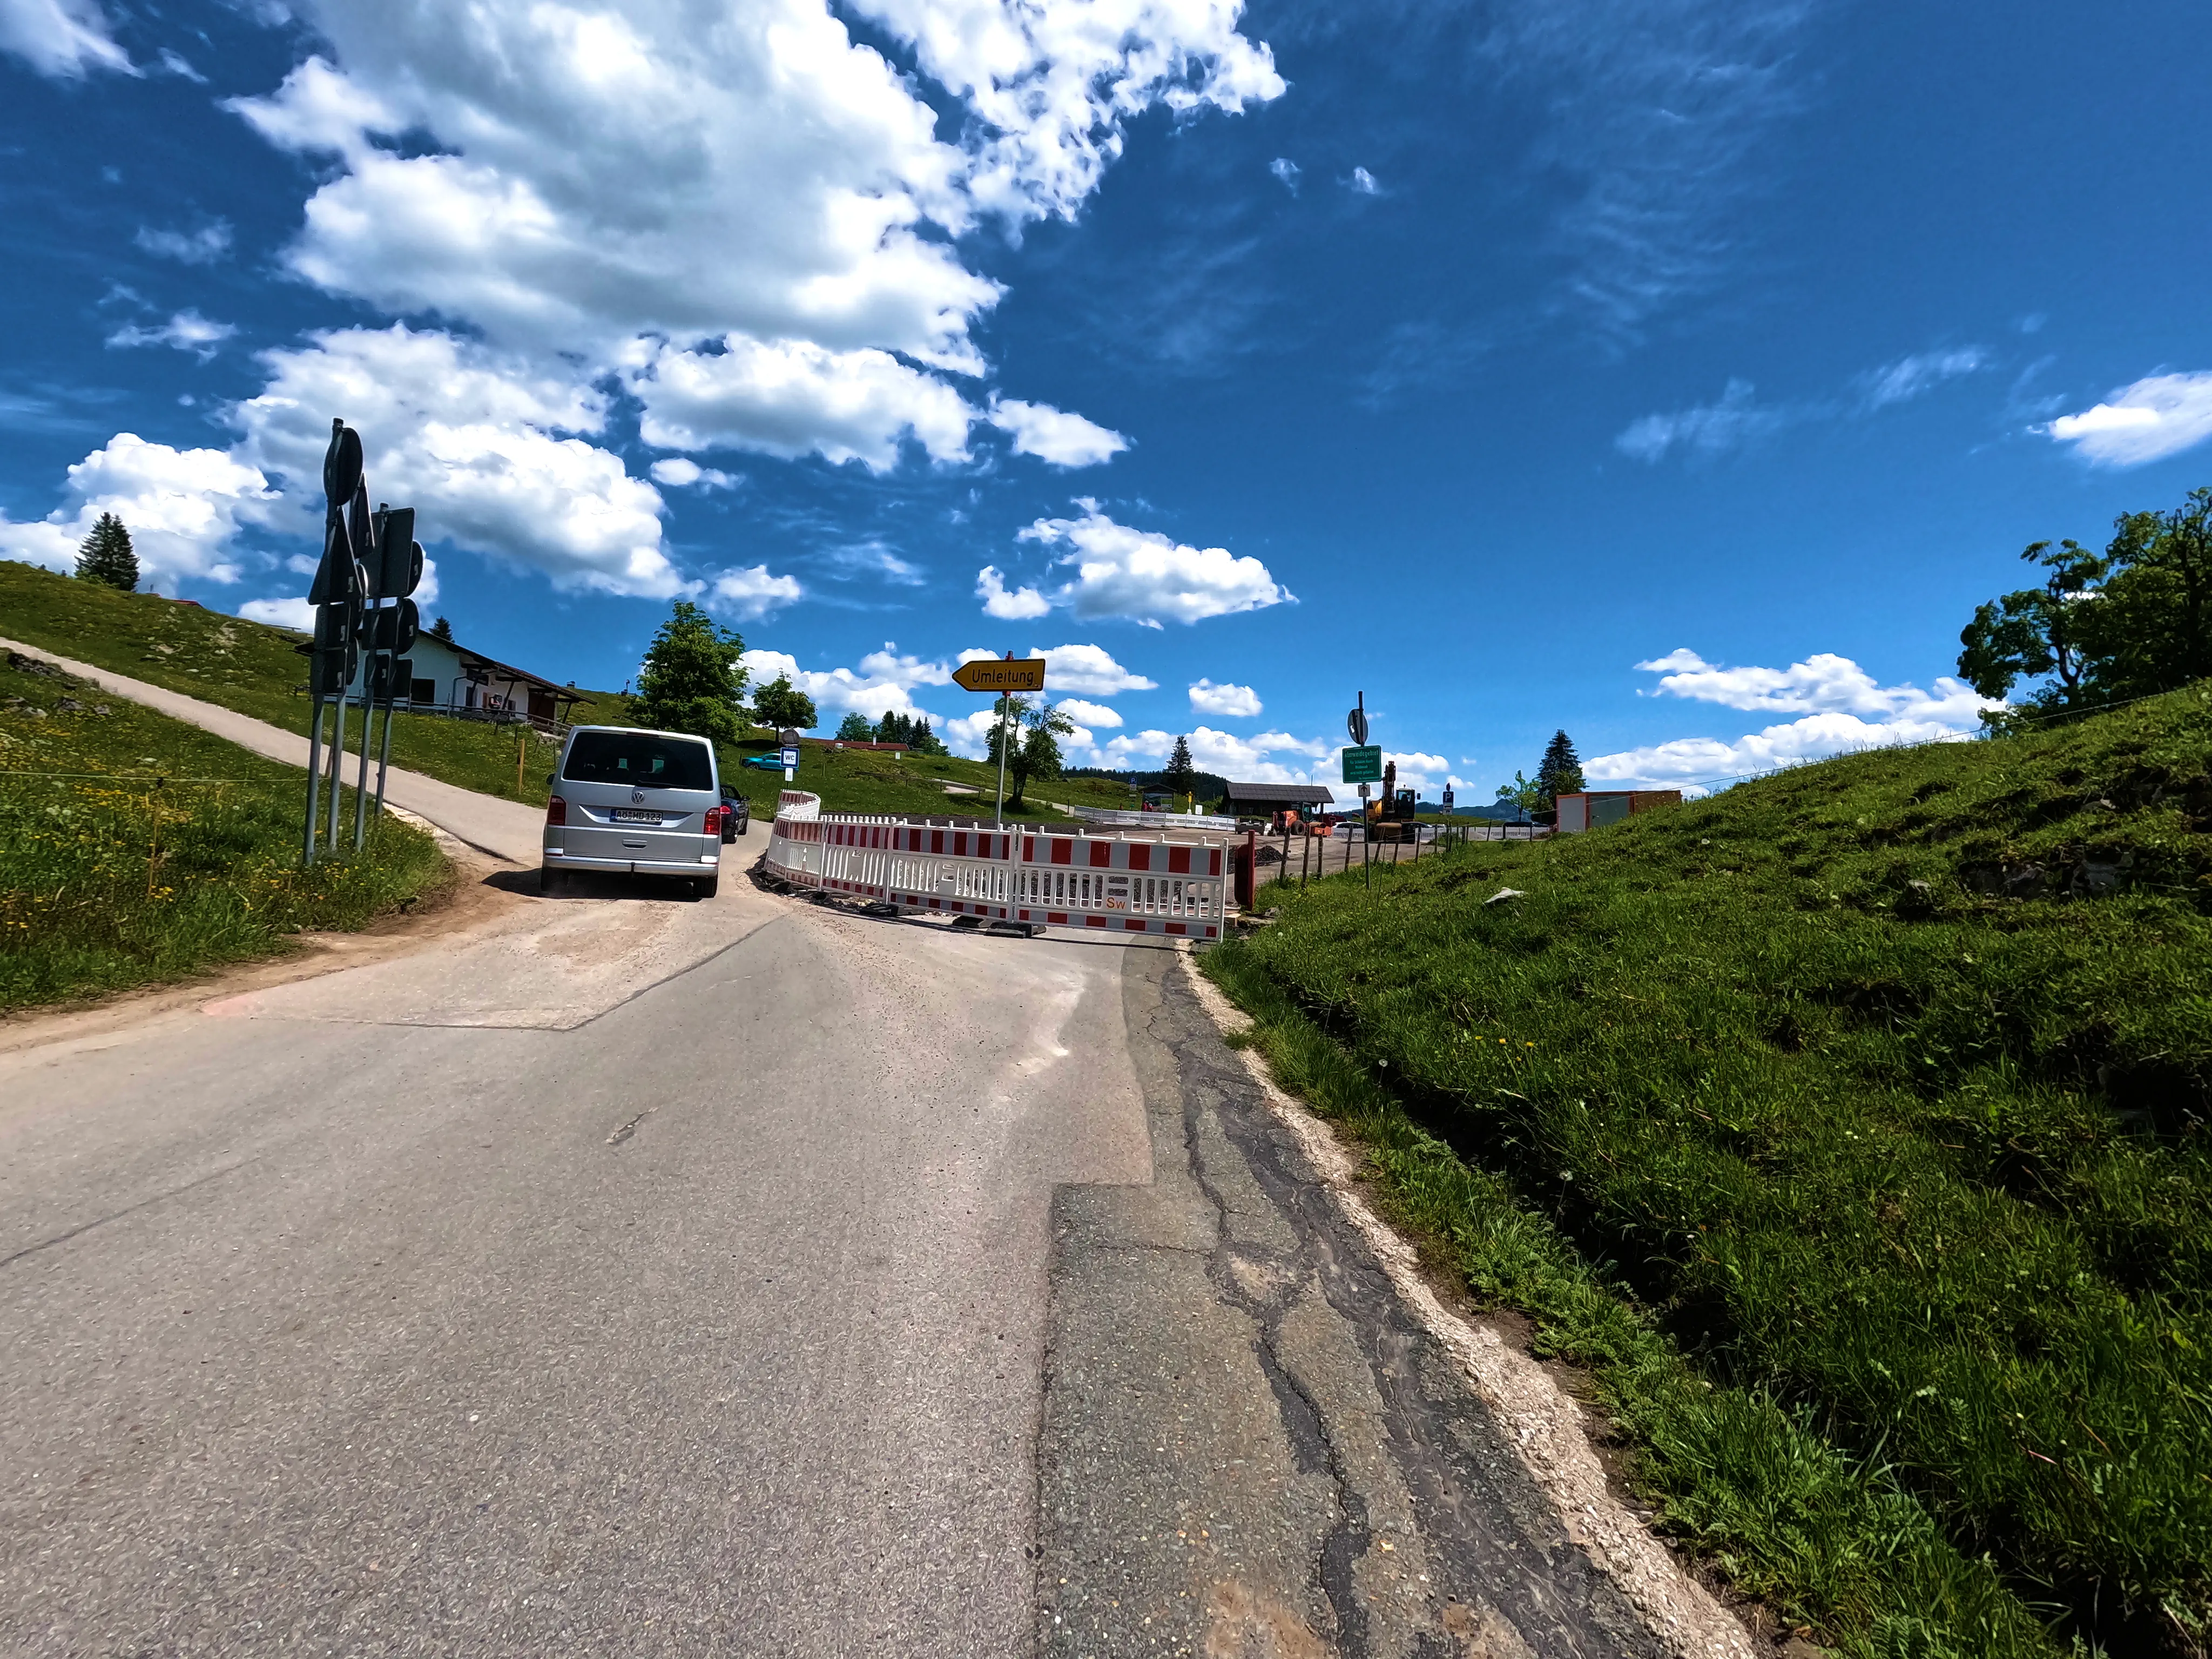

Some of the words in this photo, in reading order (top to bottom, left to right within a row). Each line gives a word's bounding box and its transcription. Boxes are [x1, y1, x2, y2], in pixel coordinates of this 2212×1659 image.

[972, 669, 1034, 686] Umleitung
[1445, 793, 1451, 801] P
[1107, 897, 1126, 909] Sw
